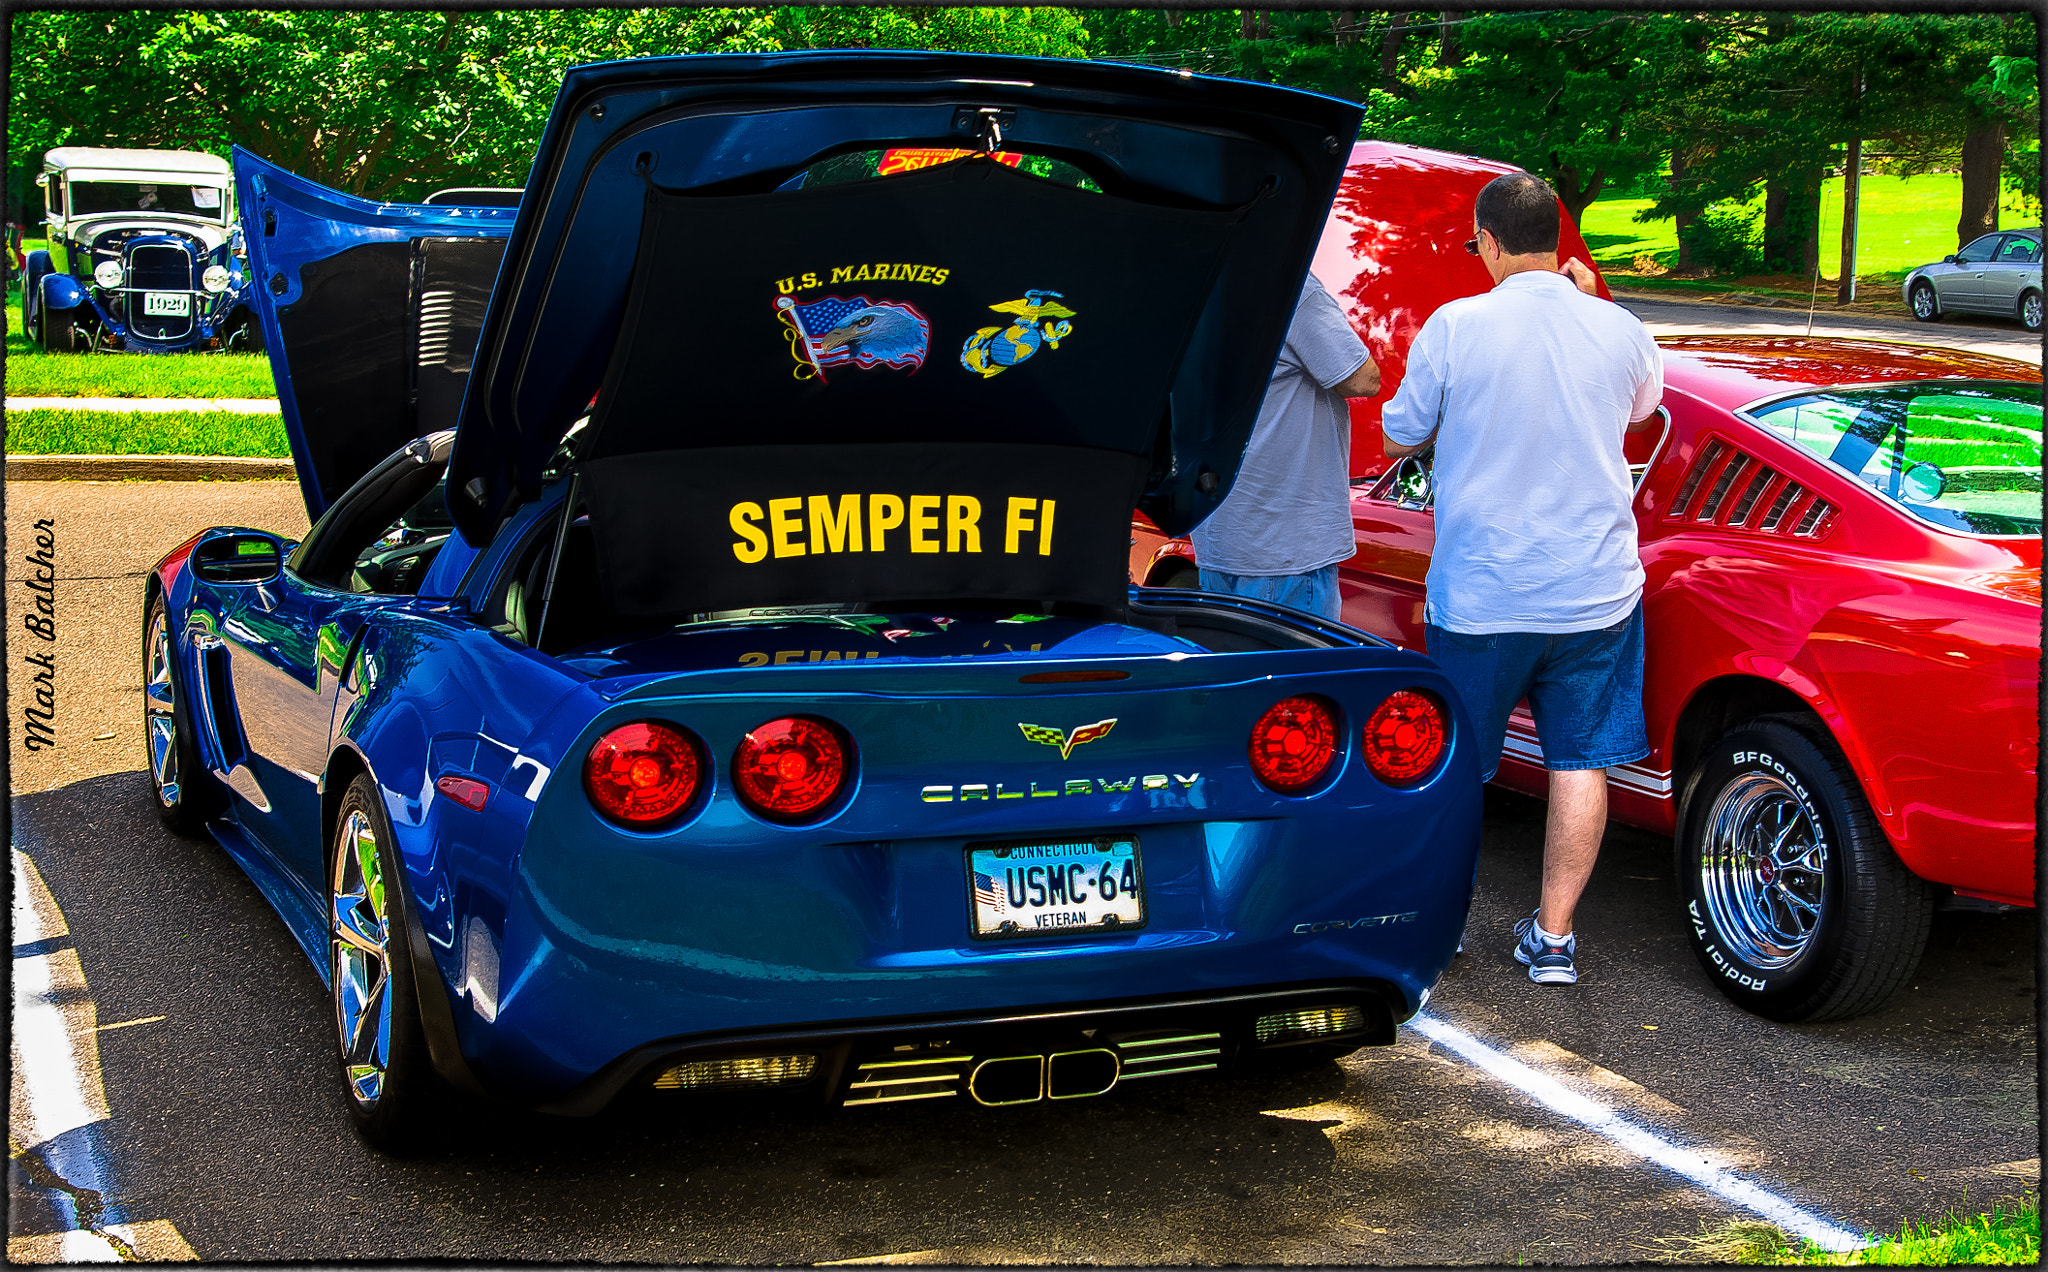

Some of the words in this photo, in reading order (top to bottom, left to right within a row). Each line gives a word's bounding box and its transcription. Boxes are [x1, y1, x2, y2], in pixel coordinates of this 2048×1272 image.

[775, 272, 823, 295] U.S.
[830, 263, 950, 286] MARINES
[148, 296, 188, 312] 1929
[729, 493, 982, 563] SEMPER
[1004, 496, 1056, 556] FI
[920, 772, 1200, 803] CALLAWAY
[1732, 751, 1829, 861] BFGoodrich
[1010, 843, 1096, 860] CONNECTICUT
[1034, 911, 1087, 928] VETERAN
[1293, 911, 1419, 934] CORVETTE
[1688, 899, 1704, 941] T/A
[1705, 944, 1767, 992] Radial
